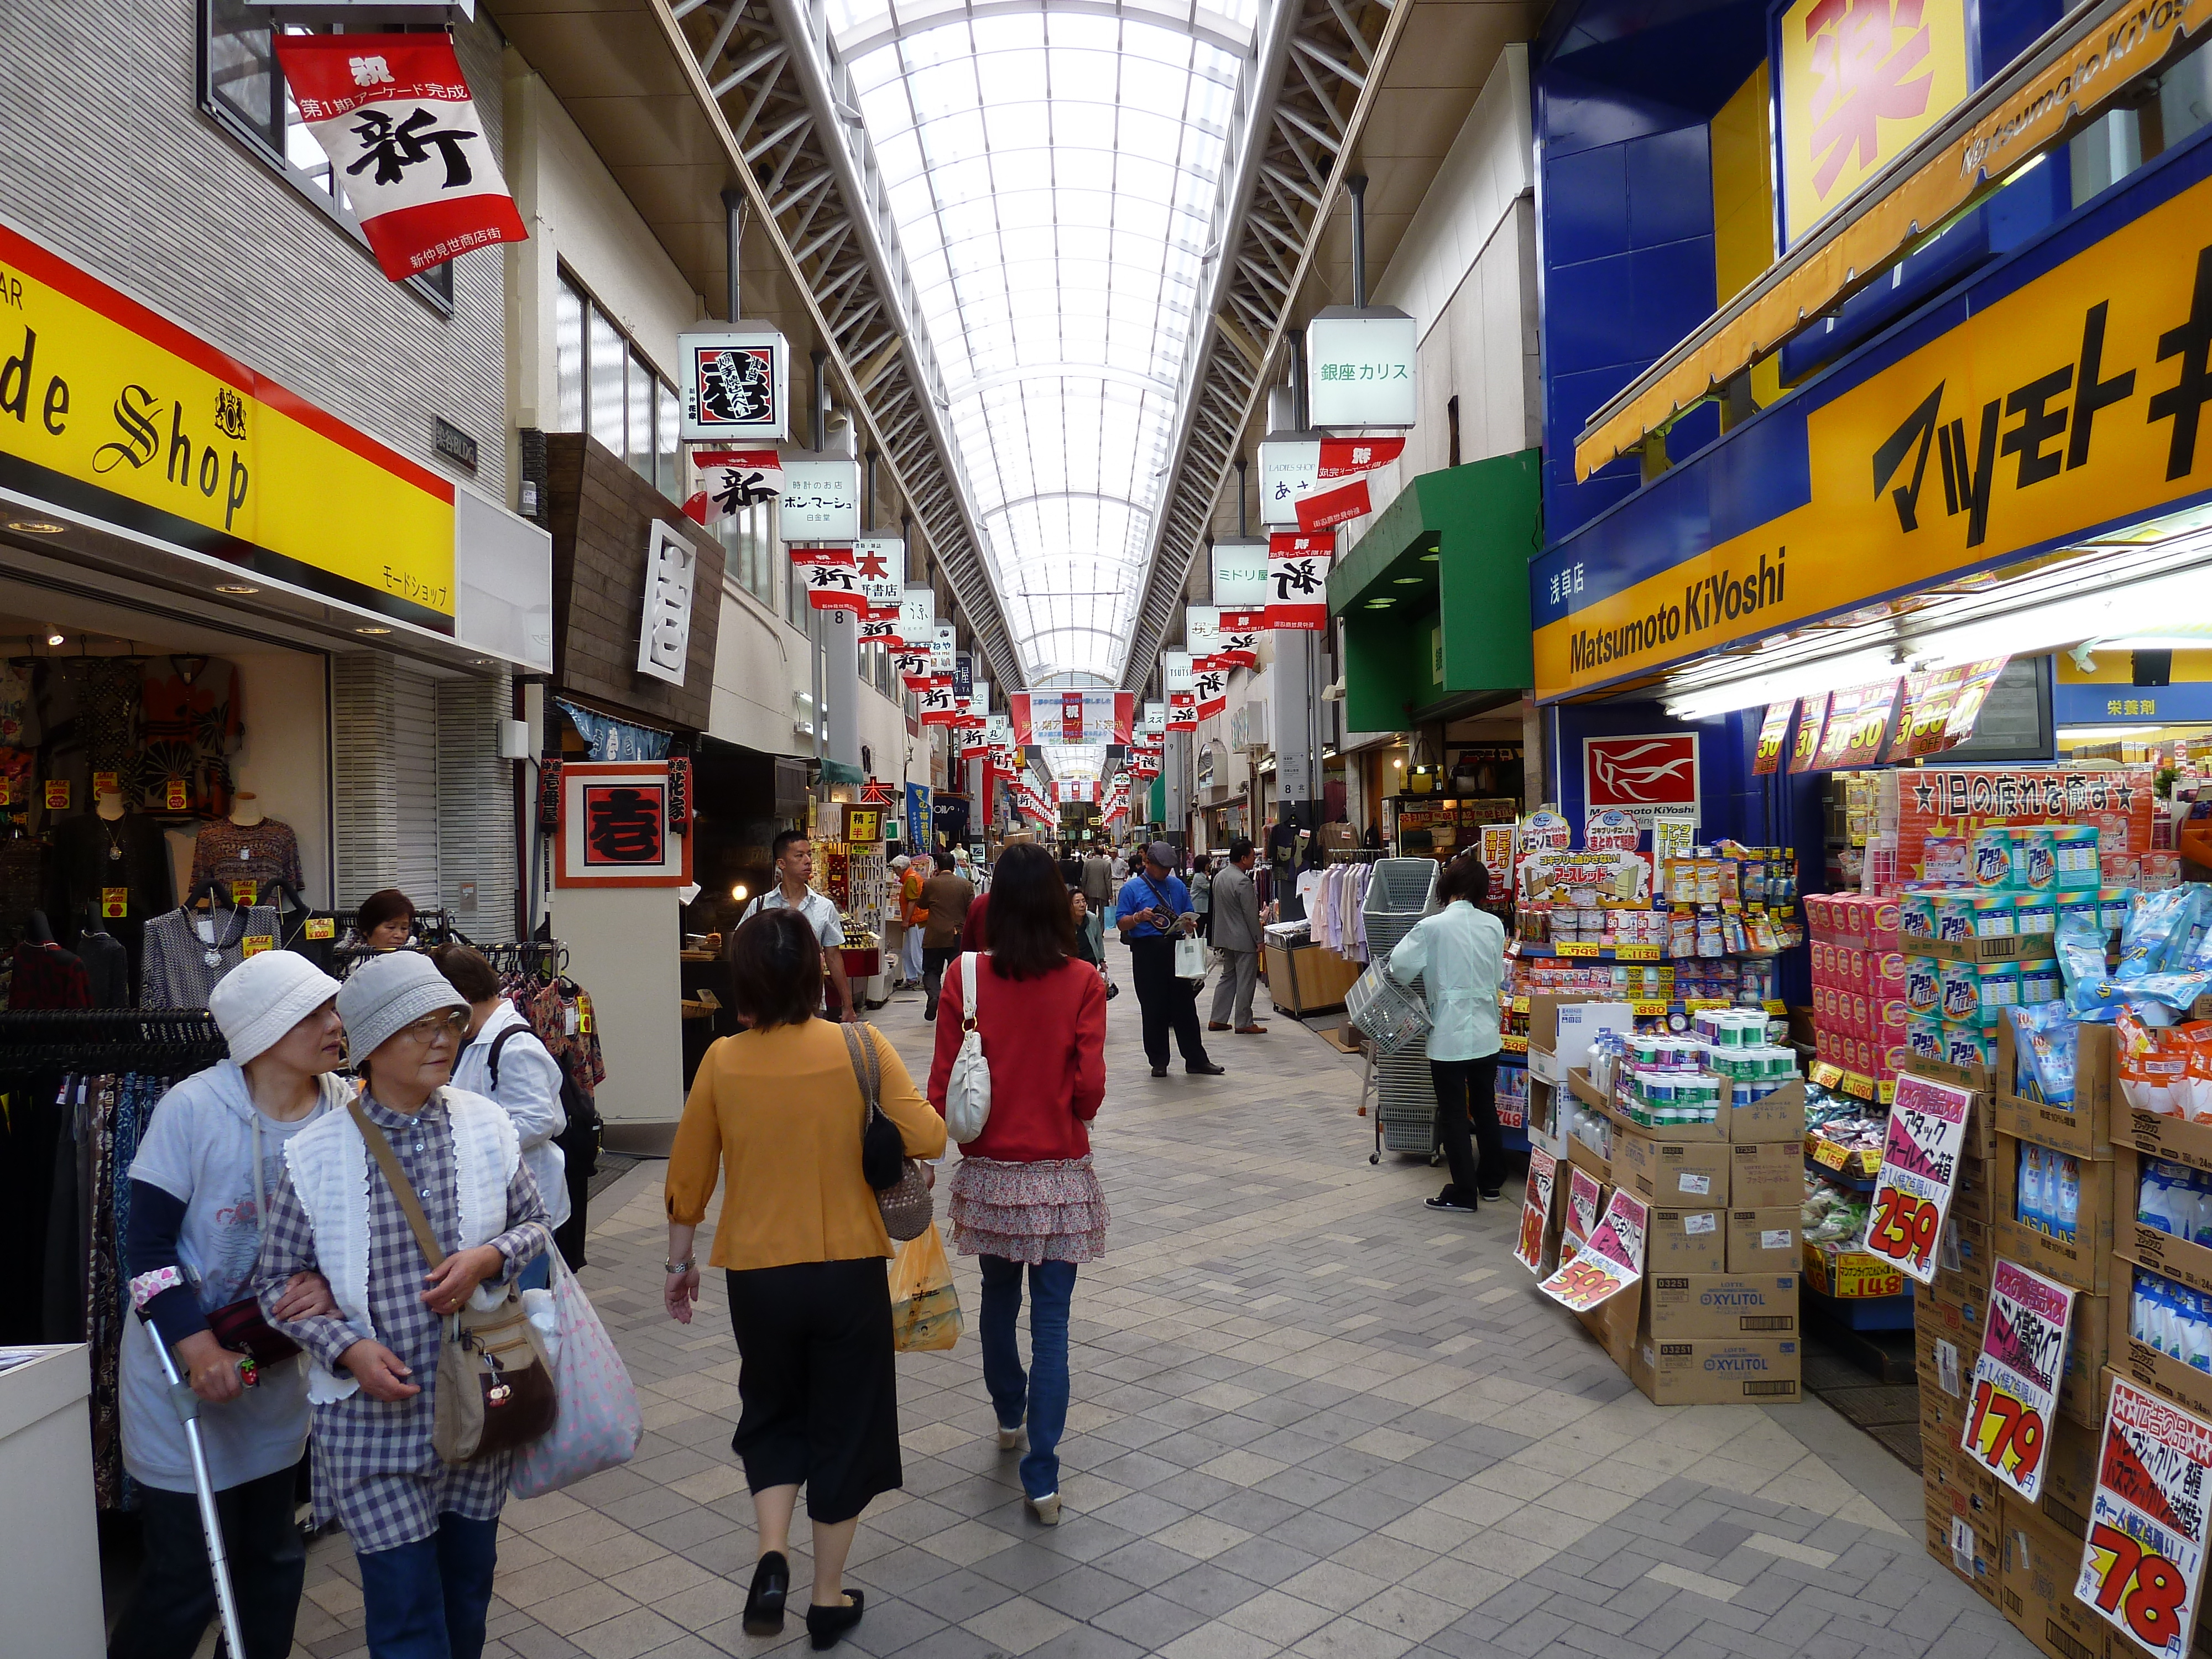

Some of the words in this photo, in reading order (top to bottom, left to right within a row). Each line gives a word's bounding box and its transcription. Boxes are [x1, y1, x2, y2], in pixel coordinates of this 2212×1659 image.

[348, 55, 395, 87] 祝
[299, 82, 468, 119] 第1期アーケード完成
[1960, 54, 2100, 180] Matsumoto
[347, 107, 478, 189] 新
[410, 227, 502, 269] 新仲見世商店街
[1321, 363, 1408, 382] 銀座カリス
[92, 384, 249, 531] Shop
[712, 468, 780, 515] 新
[792, 481, 843, 490] 時計のお店
[810, 566, 858, 590] 新
[1219, 569, 1267, 581] ミドリ屋
[1550, 561, 1584, 606] 浅草店
[383, 564, 447, 607] モードショップ
[835, 611, 843, 624] 8
[1569, 602, 1681, 674] Matsumoto
[1684, 545, 1787, 636] KiYoshi
[862, 622, 898, 636] 新
[894, 654, 929, 675] 新
[921, 690, 952, 709] 新
[2107, 699, 2155, 716] 栄養剤
[1066, 705, 1079, 718] 祝
[962, 731, 985, 745] 新
[541, 774, 561, 823] 壱番屋
[668, 773, 686, 820] 花家
[1285, 784, 1292, 794] 8
[1654, 805, 1695, 815] KiYoshi
[1498, 830, 1512, 869] ゴキブリ
[1590, 836, 1636, 849] まとめて駆除
[1553, 867, 1608, 884] アースレッド
[1607, 919, 1618, 928] 90
[1637, 919, 1648, 928] 90
[1632, 950, 1659, 959] 1134
[1639, 1006, 1666, 1014] 880
[1504, 1041, 1527, 1051] 598
[1851, 1083, 1872, 1099] 1980
[1751, 1112, 1788, 1120] ボトル
[1905, 1109, 1948, 1146] アタック
[1825, 1152, 1843, 1168] 158
[1887, 1135, 1955, 1184] オールイン箱
[1868, 1185, 1939, 1273] 259
[1918, 1256, 1932, 1275] 円
[1543, 1260, 1621, 1308] 599
[1858, 1275, 1901, 1296] 148
[1714, 1293, 1766, 1306] XYLITOL
[1717, 1359, 1768, 1371] XYLITOL
[2136, 1396, 2190, 1452] 広告の品
[1965, 1379, 2045, 1488] 179
[2020, 1470, 2036, 1493] 円
[2090, 1520, 2188, 1648] 78
[2165, 1634, 2182, 1659] 円
